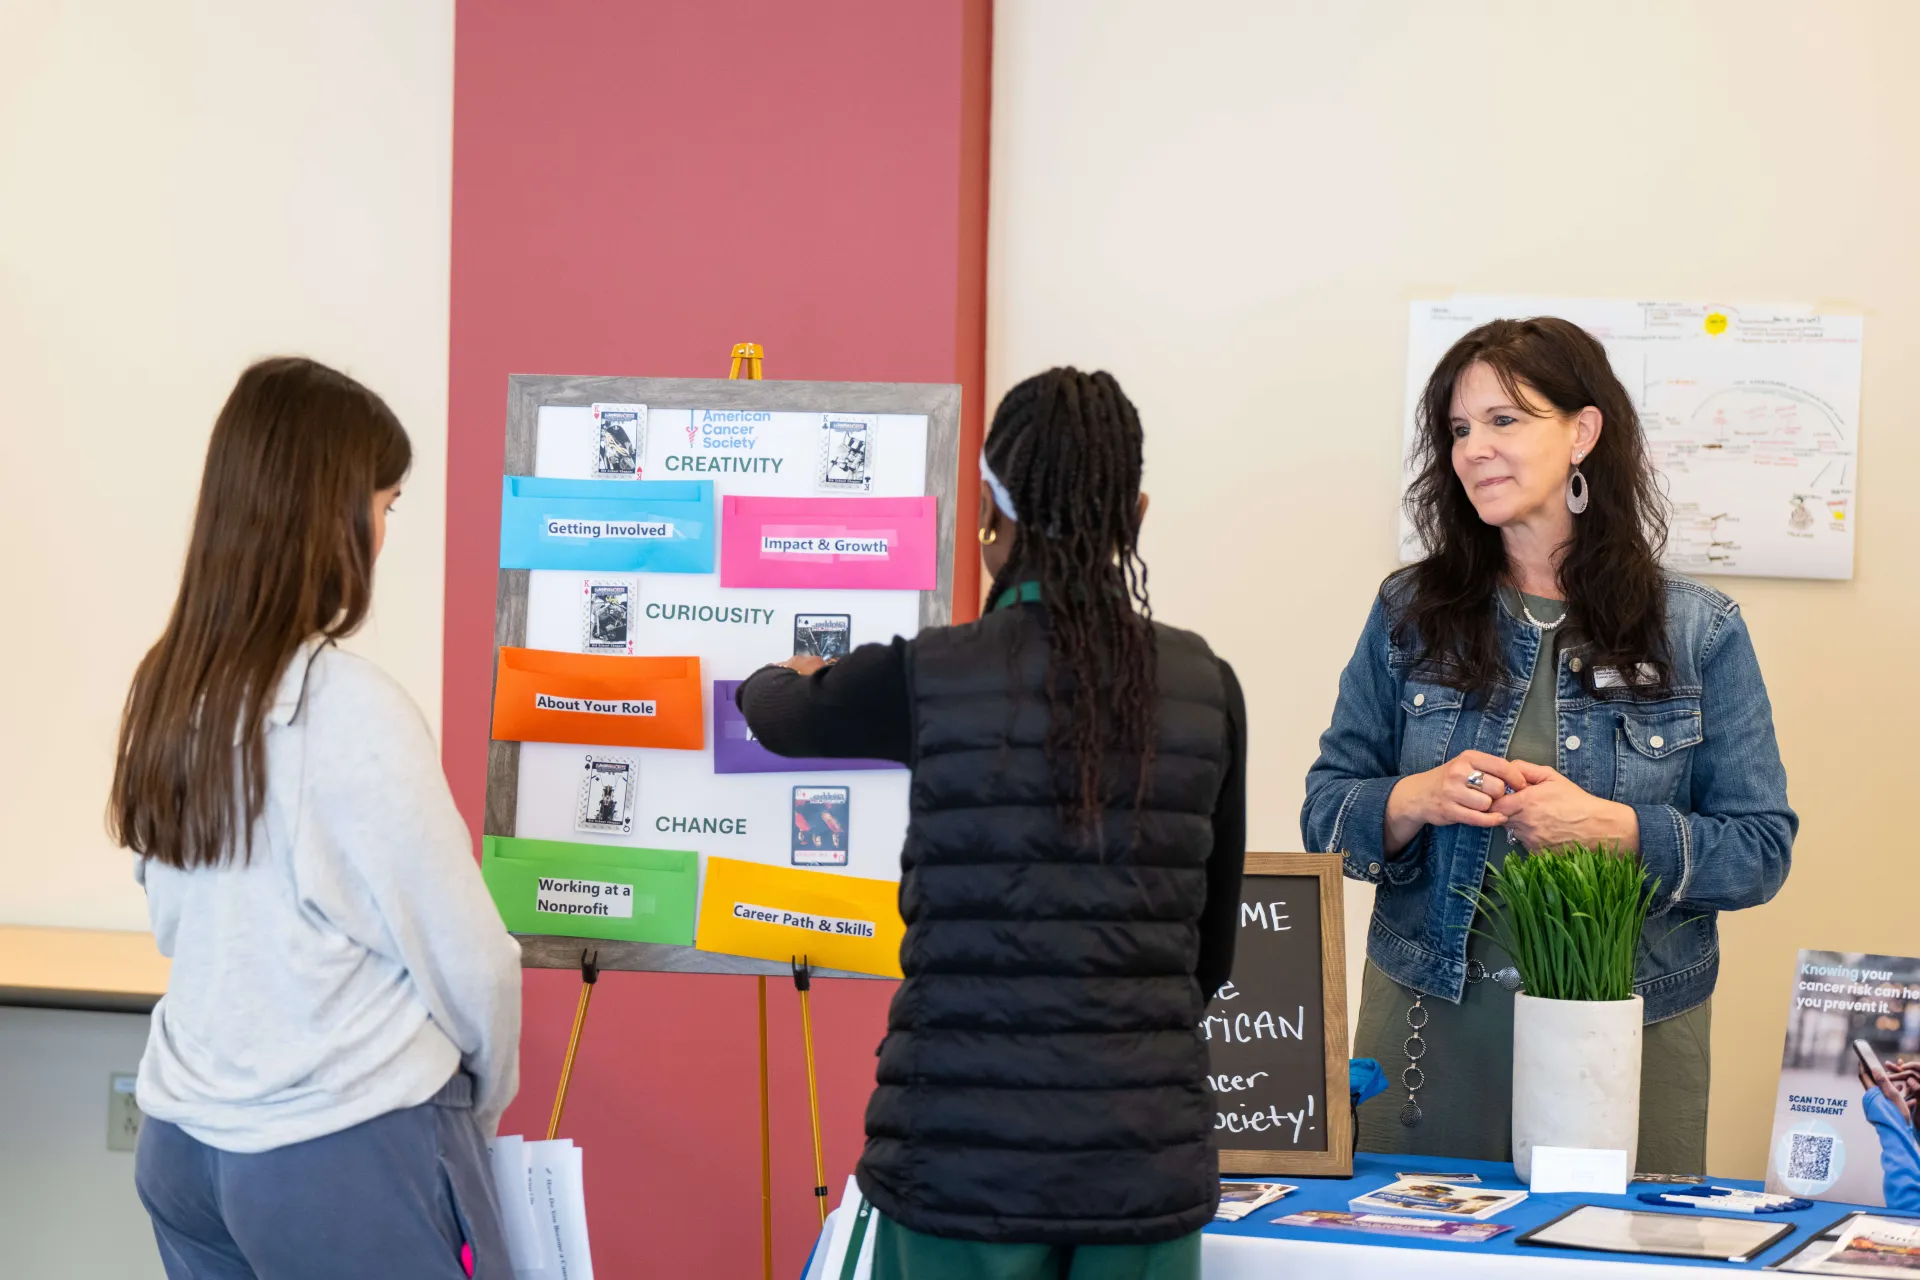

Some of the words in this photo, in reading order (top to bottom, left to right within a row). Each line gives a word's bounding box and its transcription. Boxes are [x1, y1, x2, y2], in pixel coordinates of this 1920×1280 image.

[703, 409, 771, 422] American
[702, 424, 754, 435] Cancer
[703, 437, 756, 450] Society
[665, 455, 783, 473] CREATIVITY
[548, 521, 601, 538] Getting
[605, 522, 666, 536] Involved
[764, 537, 814, 555] Impact
[818, 539, 831, 551] &
[834, 539, 888, 554] Growth
[645, 603, 775, 625] CURIOUSITY
[537, 696, 580, 712] About
[583, 699, 618, 714] Your
[622, 700, 654, 714] Role
[656, 816, 747, 835] CHANGE
[538, 878, 601, 897] Working
[604, 882, 619, 896] at
[622, 886, 631, 896] a
[538, 898, 609, 915] Nonprofit
[733, 904, 780, 923] Career
[783, 911, 815, 928] Path
[818, 918, 832, 932] &
[836, 921, 874, 938] Skills
[1801, 963, 1859, 981] Knowing
[1861, 969, 1893, 982] your
[1799, 981, 1846, 994] cancer
[1847, 982, 1873, 996] risk
[1874, 987, 1900, 998] can
[1902, 986, 1920, 1000] he
[1796, 997, 1822, 1010] you
[1823, 1000, 1876, 1012] prevent
[1878, 1002, 1890, 1014] it.
[1789, 1095, 1812, 1104] SCAN
[1814, 1097, 1825, 1105] TO
[1827, 1098, 1848, 1107] TAKE
[1790, 1104, 1844, 1115] ASSESSMENT
